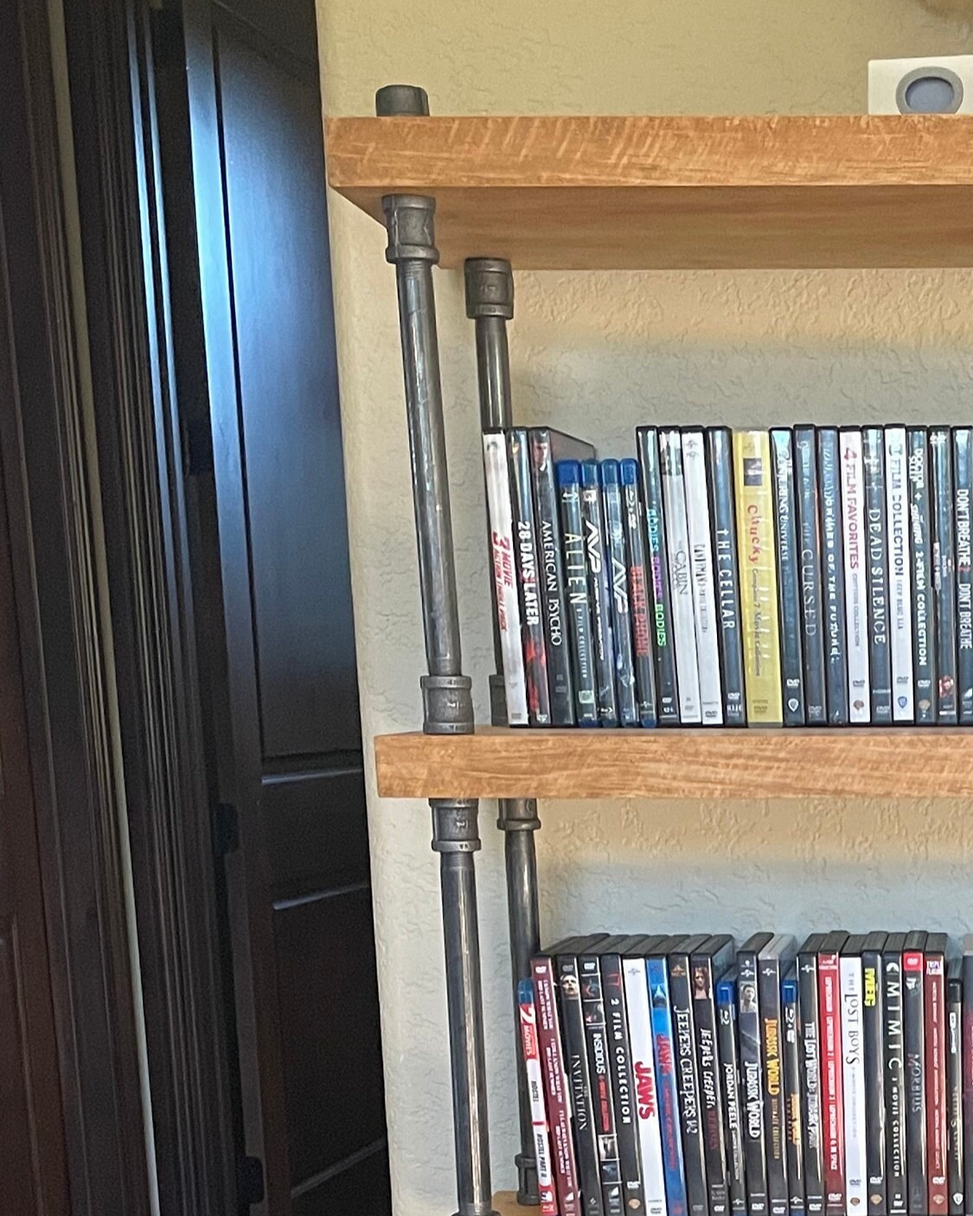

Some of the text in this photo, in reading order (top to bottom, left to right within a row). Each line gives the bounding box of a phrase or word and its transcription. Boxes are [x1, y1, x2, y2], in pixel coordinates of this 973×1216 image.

[586, 520, 601, 573] AVP
[780, 516, 788, 560] UNIVERSE
[848, 497, 858, 569] FAVORITES
[893, 494, 903, 576] COLLECTION
[958, 521, 971, 564] BREATHE
[503, 550, 513, 589] MOVIE
[519, 521, 539, 625] 28 DAYS LATER
[542, 521, 561, 645] AMERICAN PSYCHO
[565, 533, 587, 604] ALIEN
[612, 557, 628, 613] AVP
[647, 509, 666, 646] BODIES BODIES BODIES
[675, 551, 688, 595] CABIN
[802, 549, 816, 636] CURSED
[827, 554, 835, 573] OF
[869, 508, 885, 644] DEAD SILENCE
[721, 570, 735, 629] CELLAR
[918, 594, 927, 665] COLLECTION
[960, 612, 973, 649] BREATHE
[520, 1004, 535, 1023] 2
[613, 1012, 622, 1039] FILM
[844, 994, 859, 1023] LOST
[887, 981, 901, 1070] MIMIC
[593, 1033, 605, 1073] INSIDIOUS
[656, 1033, 671, 1076] JAWS
[674, 1006, 695, 1117] JEEPERS CREEPERS
[764, 1018, 779, 1095] JURASSIC WORLD
[805, 1022, 816, 1058] THE LOST
[846, 1031, 859, 1064] BOYS
[571, 1055, 587, 1130] INVITATION
[616, 1047, 630, 1123] COLLECTION
[635, 1061, 655, 1119] JAWS
[724, 1063, 737, 1128] JORDAN PEELE
[747, 1100, 761, 1138] WORLD
